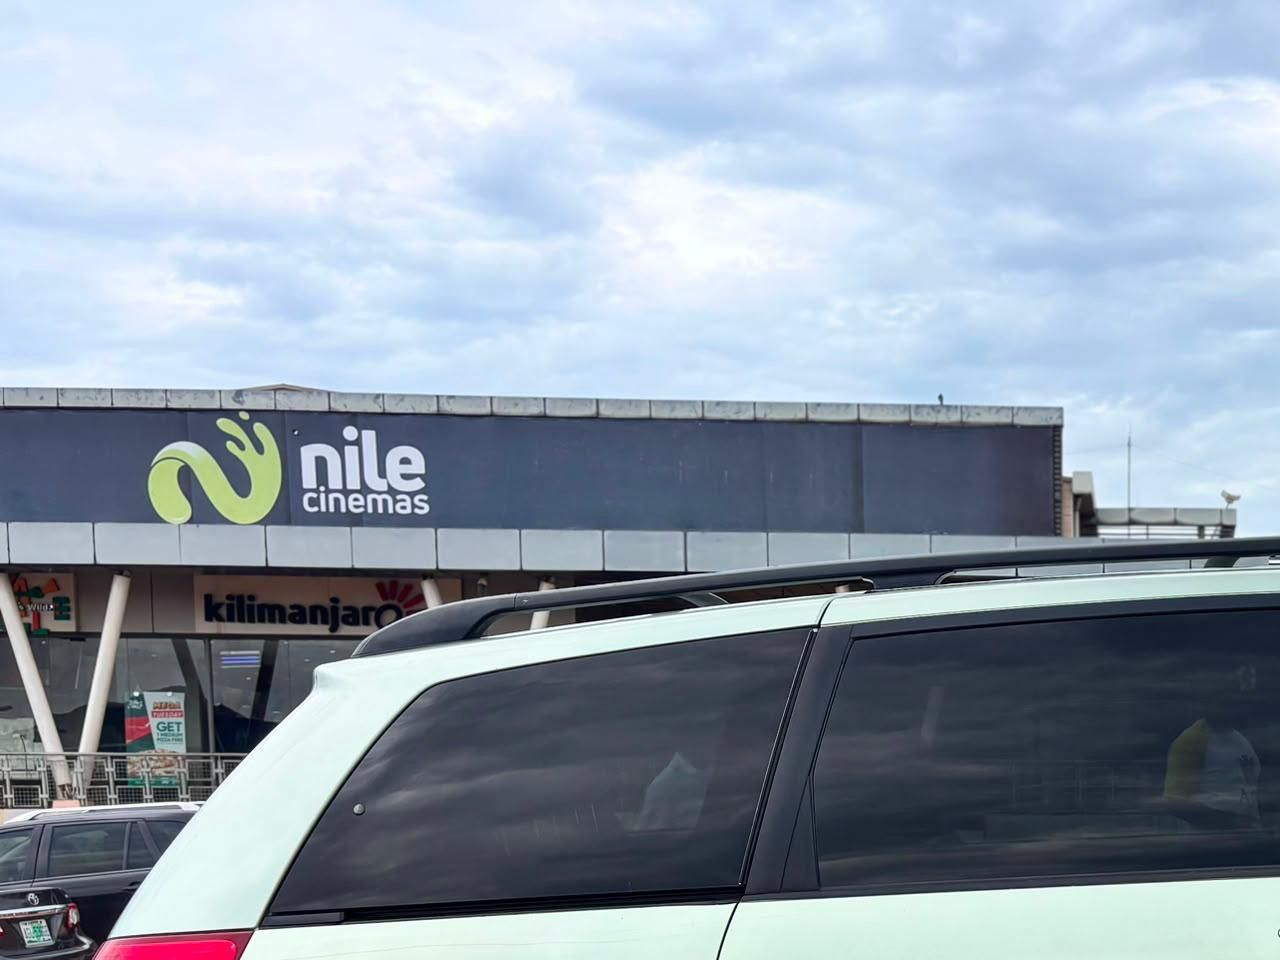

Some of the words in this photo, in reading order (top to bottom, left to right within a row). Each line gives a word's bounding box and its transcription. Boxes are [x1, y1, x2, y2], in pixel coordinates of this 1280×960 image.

[300, 425, 426, 492] nile
[302, 485, 430, 515] cinemas
[203, 593, 403, 633] kilimanjaro
[156, 721, 183, 732] GET
